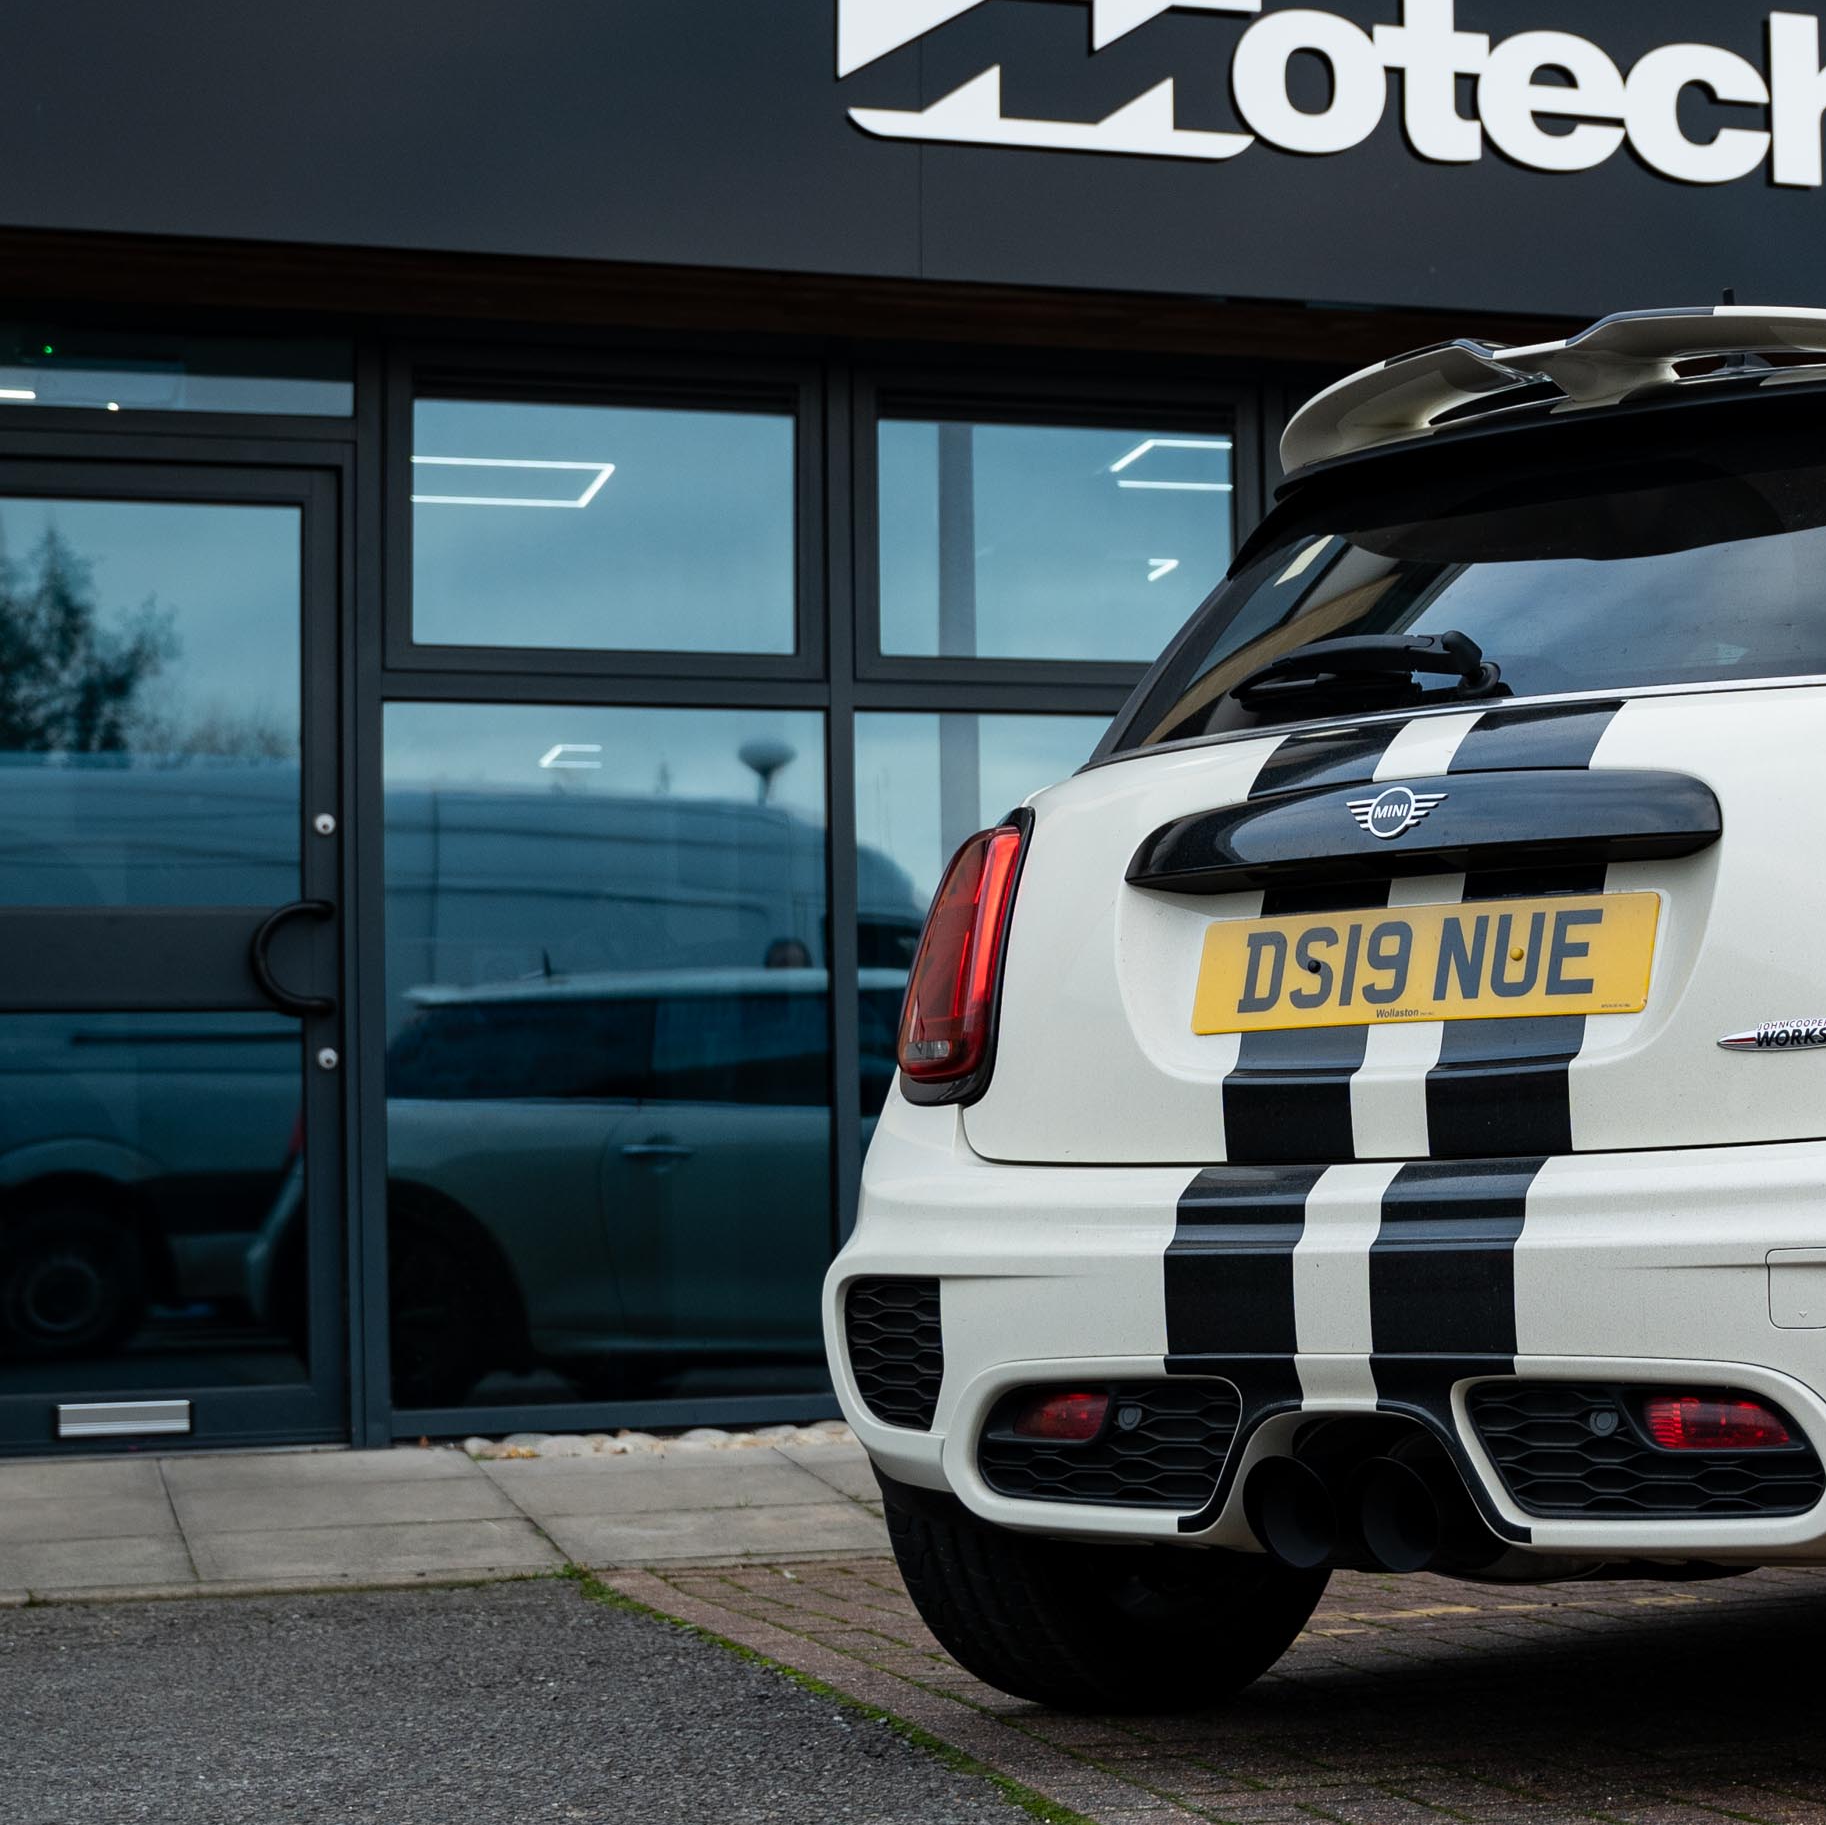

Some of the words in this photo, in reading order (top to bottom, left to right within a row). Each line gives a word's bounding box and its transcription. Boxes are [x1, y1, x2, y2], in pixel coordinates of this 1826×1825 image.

[1373, 803, 1409, 819] MINI
[1237, 920, 1413, 1014] DS19
[1432, 908, 1604, 1002] NUE
[1376, 1008, 1419, 1019] Wollaston
[1758, 1021, 1786, 1031] JOHN
